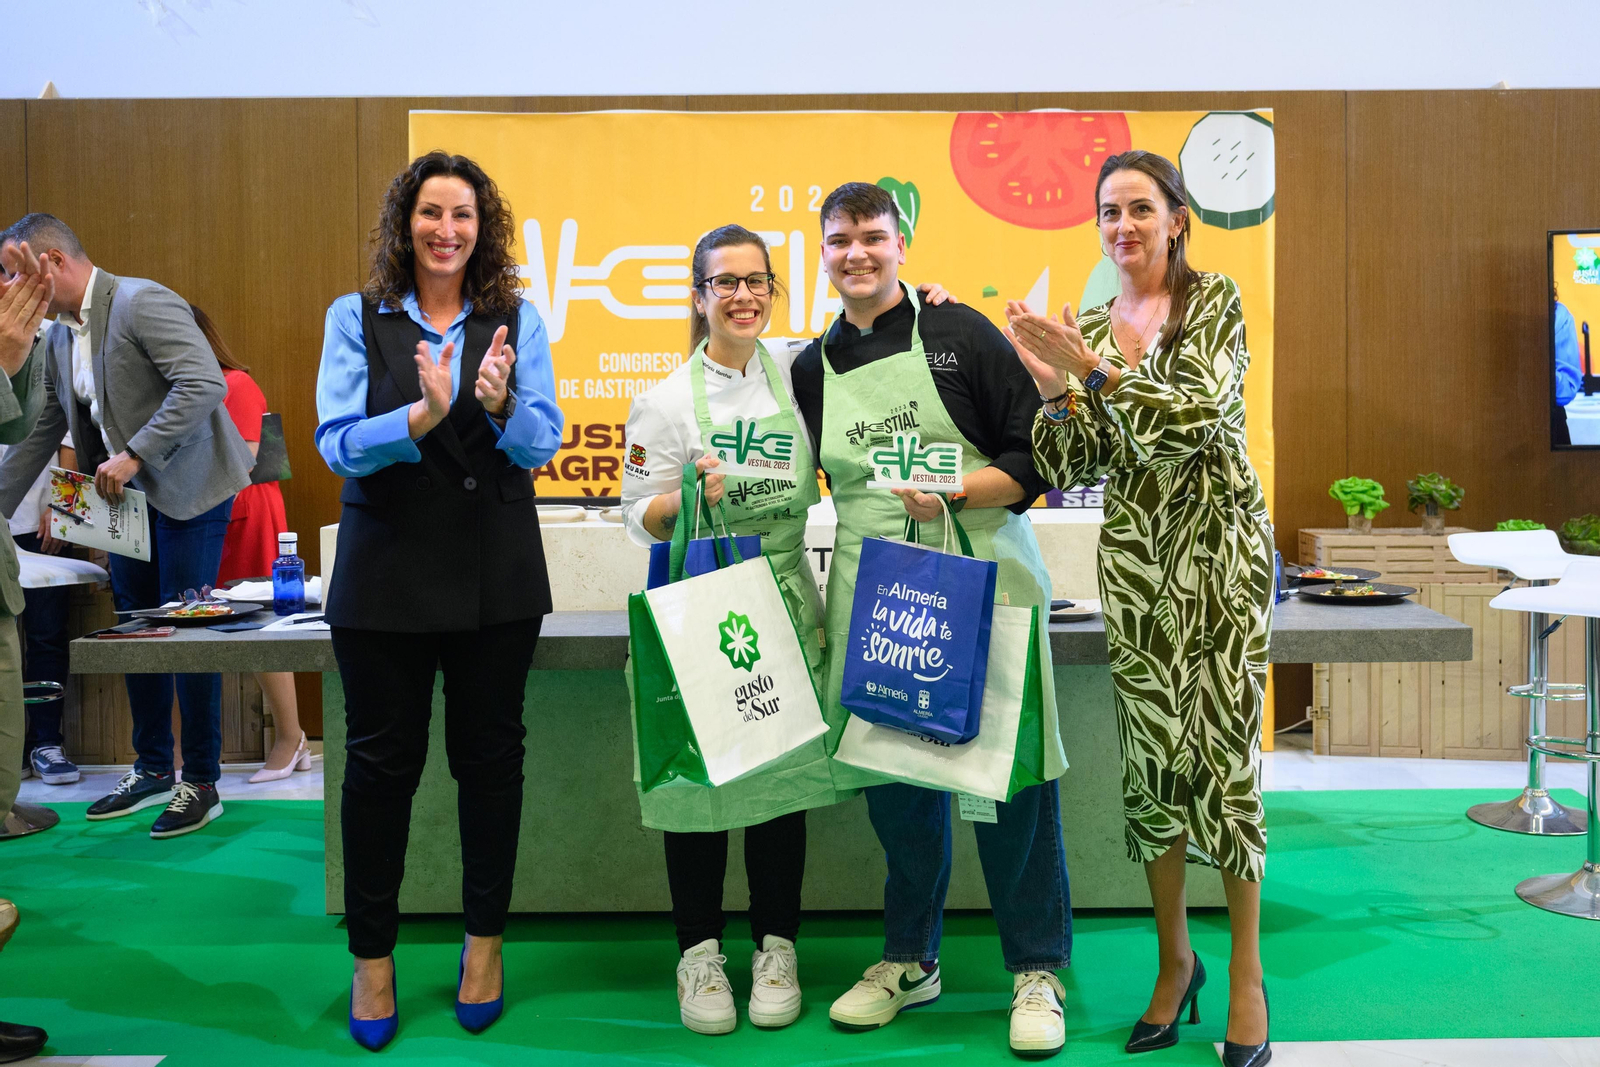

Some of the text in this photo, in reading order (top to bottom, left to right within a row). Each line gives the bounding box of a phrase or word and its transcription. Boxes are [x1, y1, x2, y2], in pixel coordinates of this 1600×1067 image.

[750, 185, 822, 212] 202
[599, 352, 683, 373] CONGRESO
[560, 379, 580, 399] DE
[532, 455, 625, 482] AGR
[747, 459, 790, 470] VESTIAL 2023
[912, 474, 956, 484] VESTIAL 2023
[877, 582, 947, 610] En Almería
[872, 599, 952, 640] la vida te
[655, 694, 674, 703] Junta
[734, 673, 774, 712] gusto
[878, 684, 908, 702] Almería
[743, 696, 780, 723] del Sur
